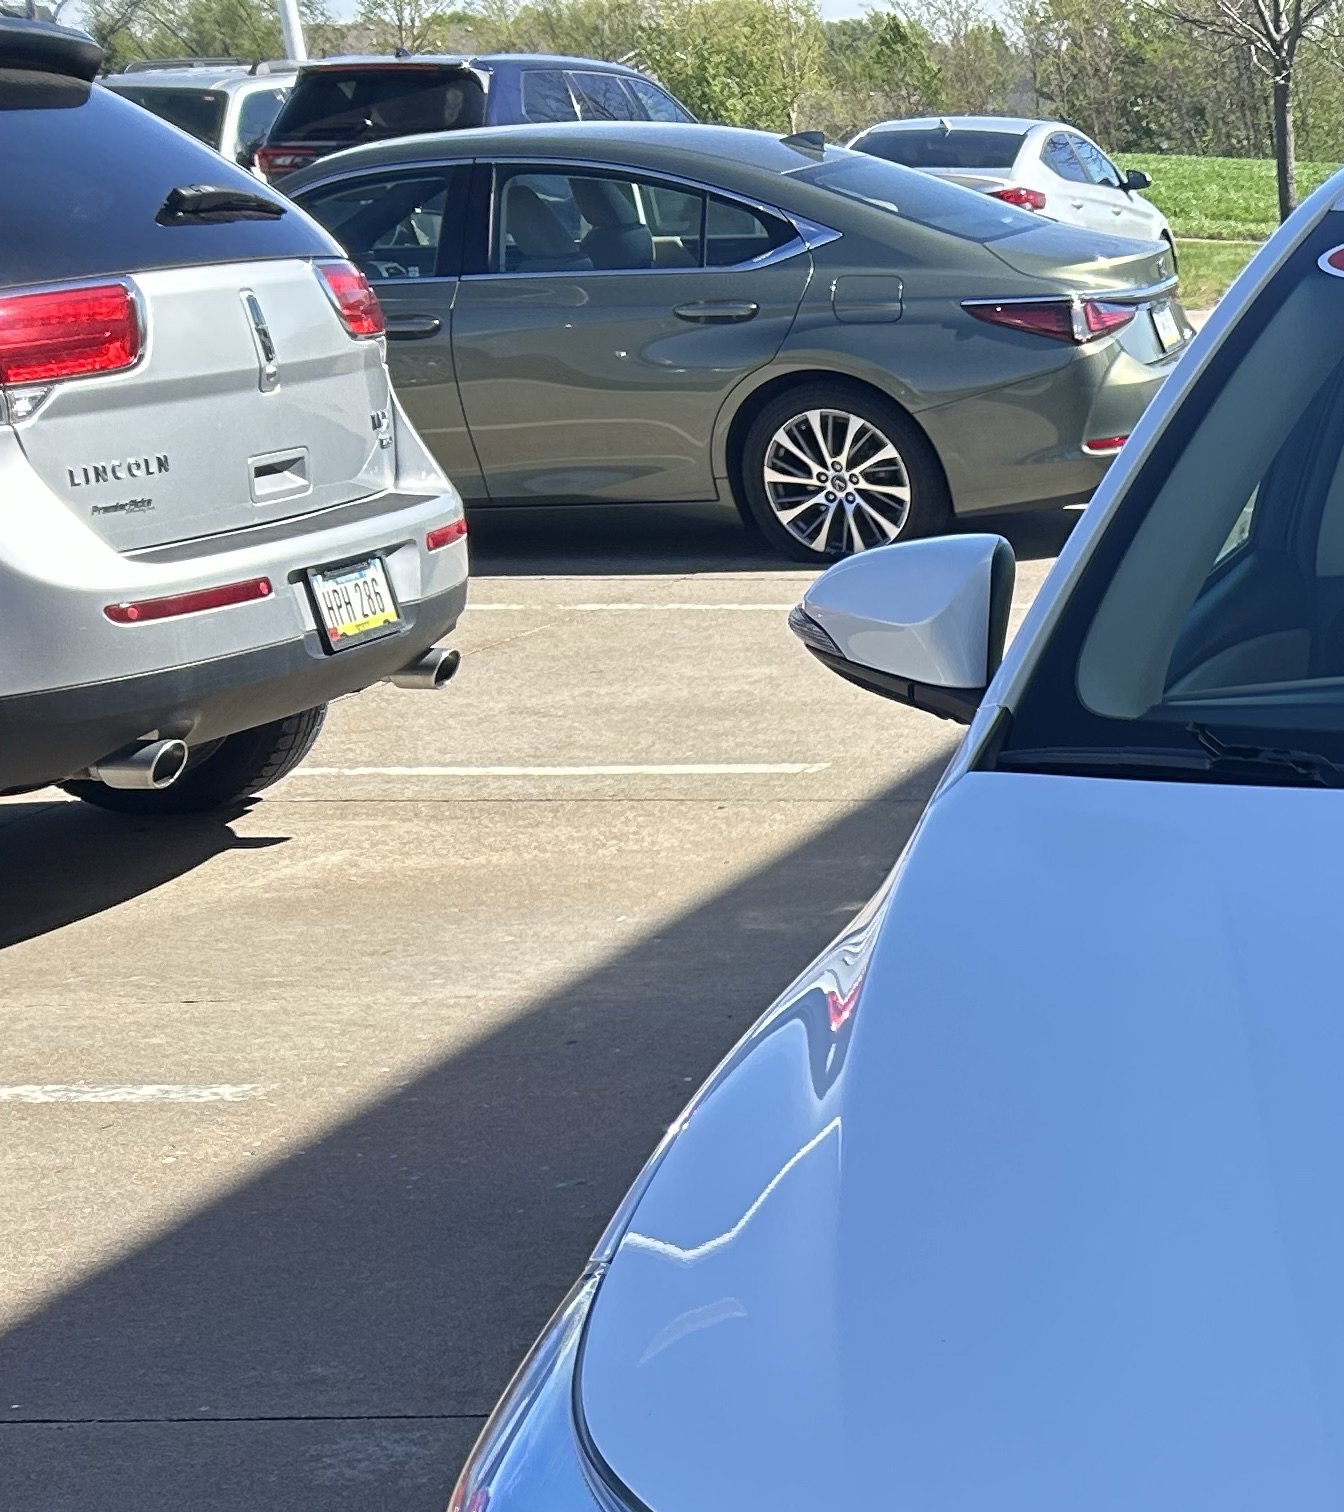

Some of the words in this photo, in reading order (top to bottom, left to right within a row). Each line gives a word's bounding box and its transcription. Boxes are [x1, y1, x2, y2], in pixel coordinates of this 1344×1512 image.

[67, 454, 170, 488] LINCOLN
[322, 584, 357, 629] HPH
[354, 577, 386, 619] 286
